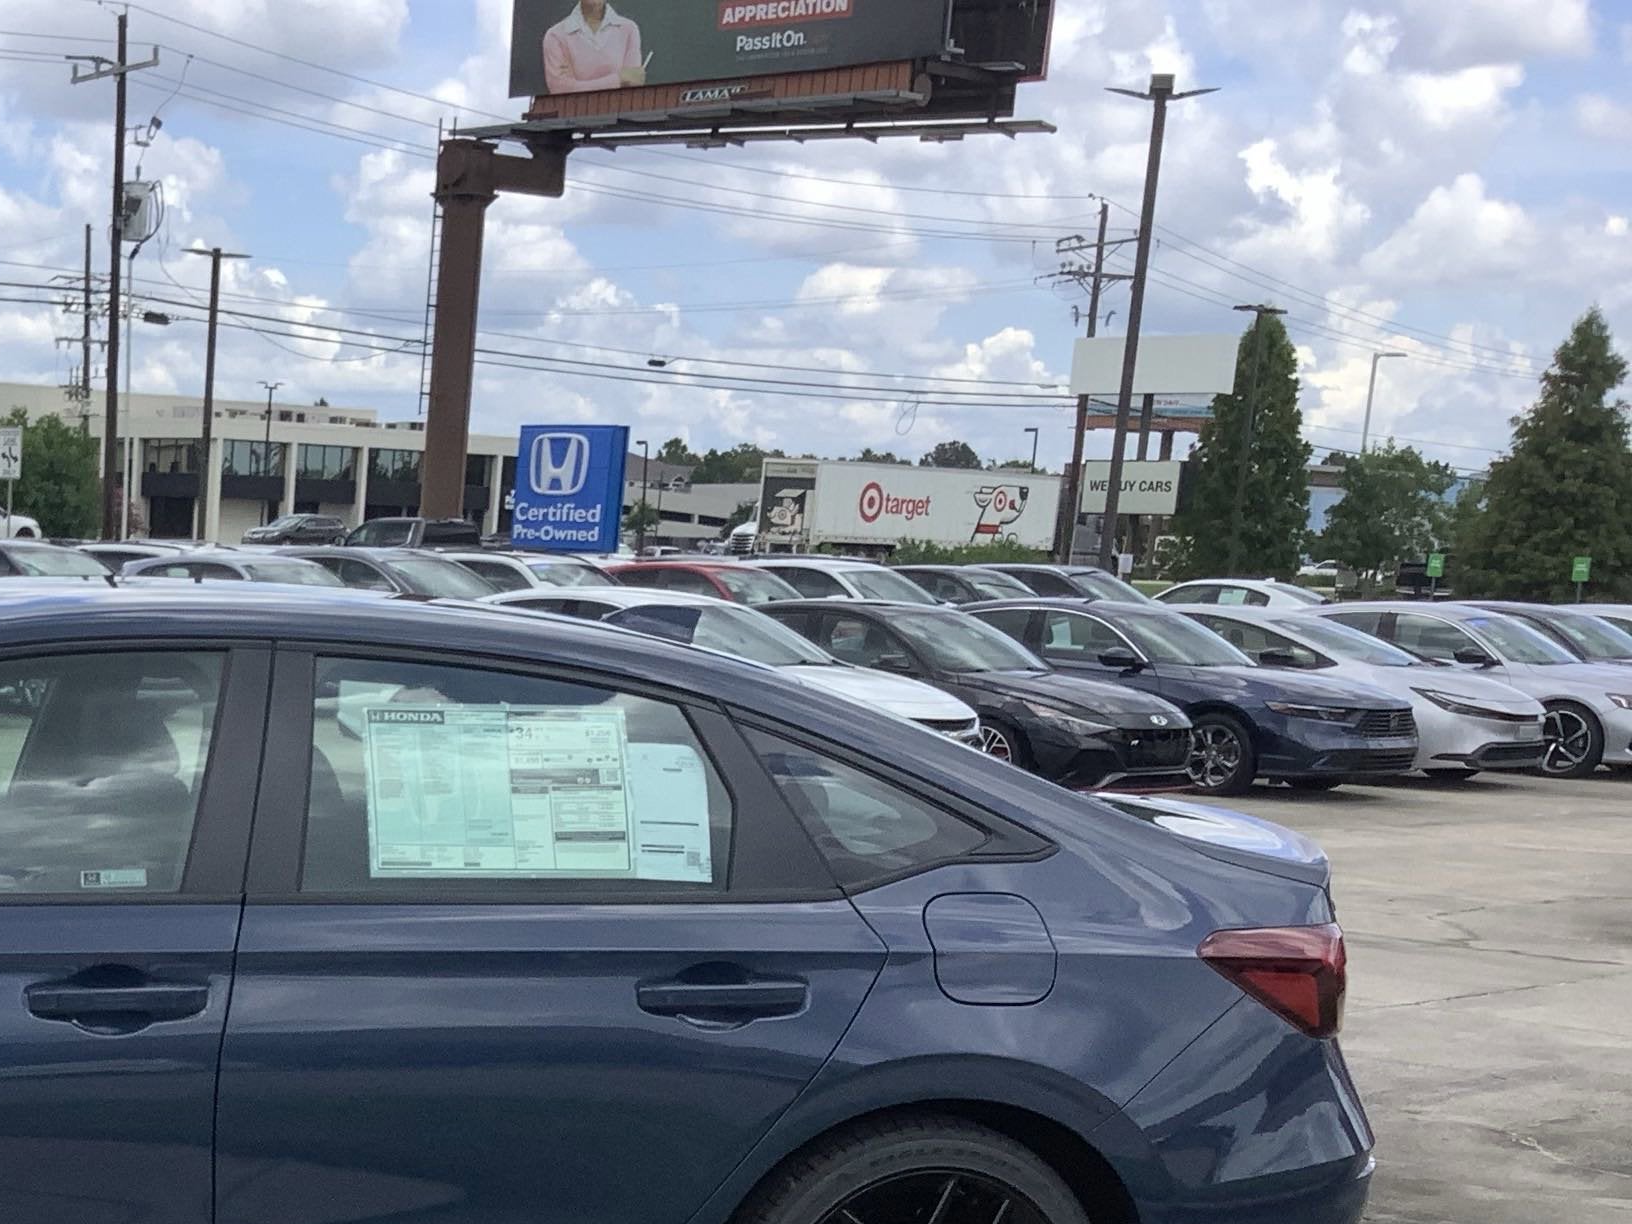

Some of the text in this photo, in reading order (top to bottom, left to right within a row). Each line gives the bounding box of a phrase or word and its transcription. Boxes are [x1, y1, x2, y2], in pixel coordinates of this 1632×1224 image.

[722, 0, 848, 24] APPRECIATION
[1089, 480, 1173, 493] WE UY CARS
[515, 502, 602, 523] Certified
[884, 493, 932, 521] target
[512, 524, 599, 542] Pre-Owned
[383, 711, 443, 722] HONDA
